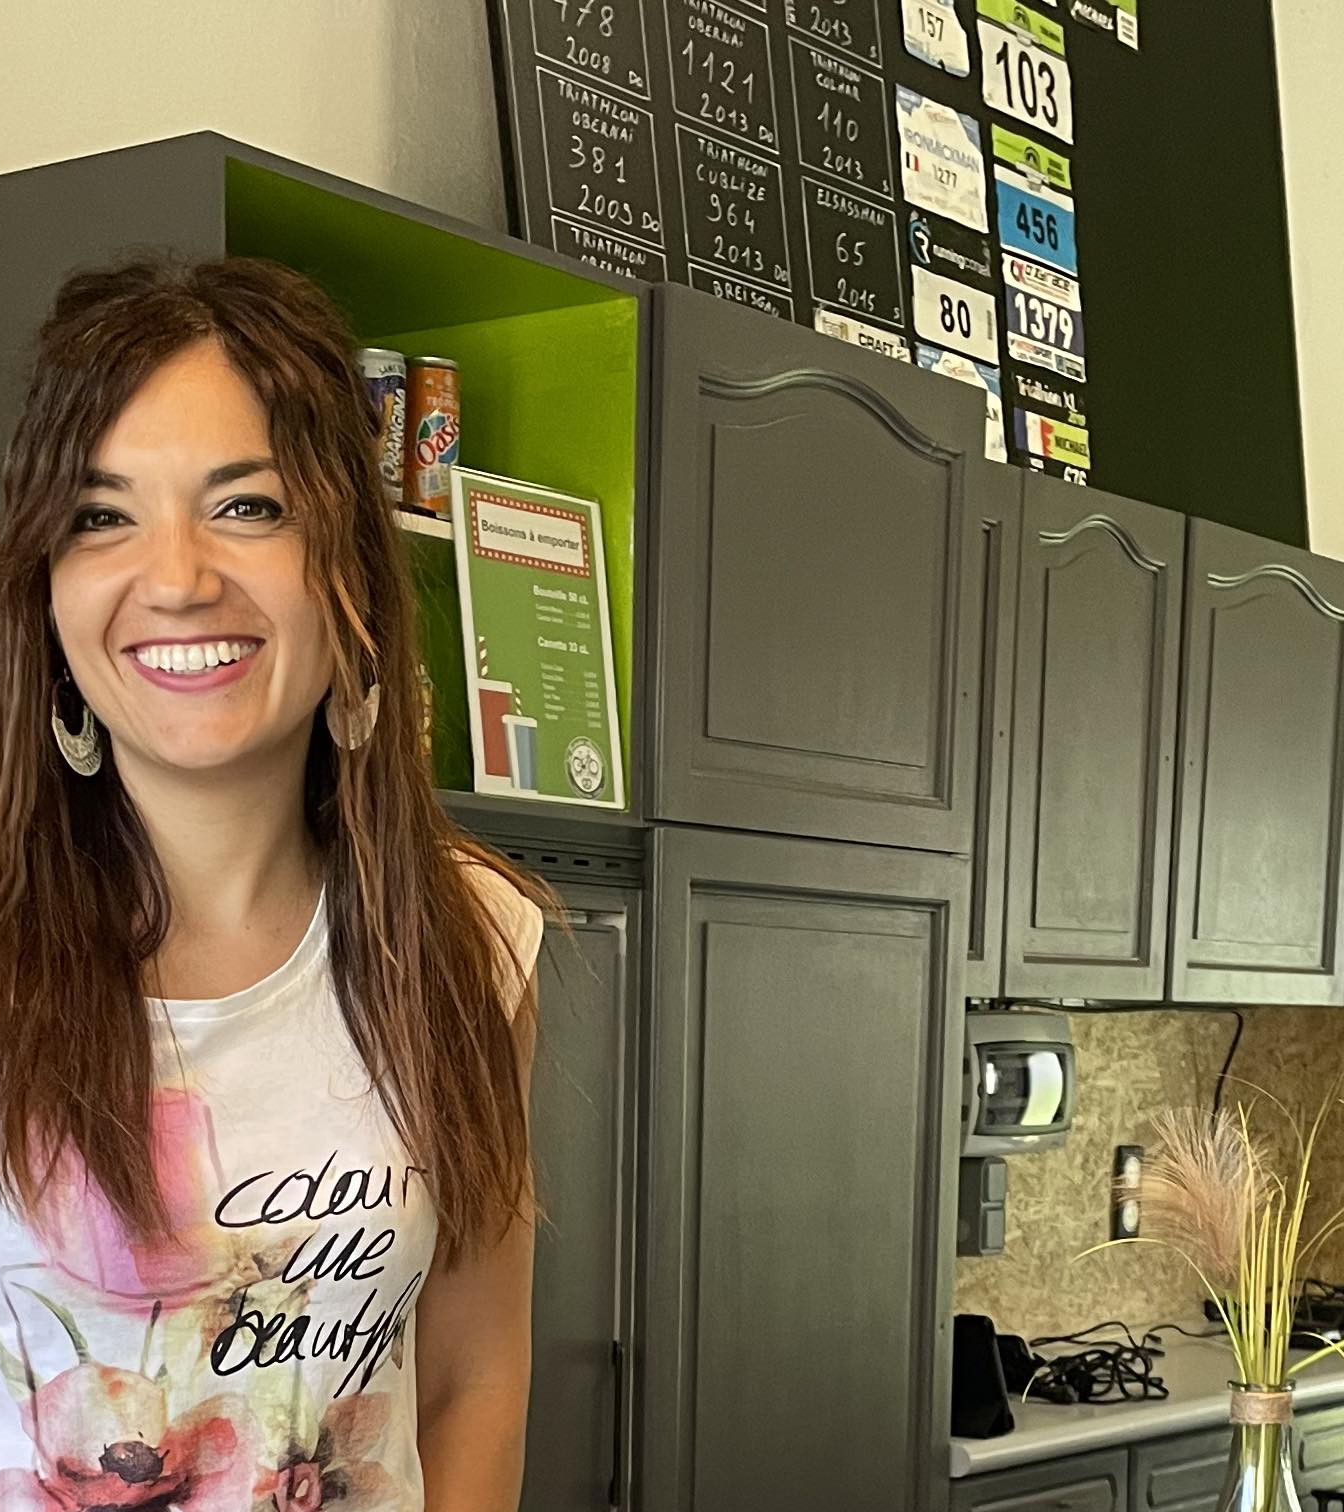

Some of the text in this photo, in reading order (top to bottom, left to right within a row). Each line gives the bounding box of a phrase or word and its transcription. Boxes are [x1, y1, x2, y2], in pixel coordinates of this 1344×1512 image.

[810, 6, 852, 46] 2013
[918, 8, 944, 42] 157
[566, 36, 611, 74] 2008
[681, 40, 754, 104] 1121
[996, 41, 1058, 128] 103
[700, 93, 748, 132] 2013
[817, 102, 859, 141] 110
[568, 135, 626, 183] 381
[822, 146, 864, 180] 2013
[577, 184, 633, 225] 2009
[706, 193, 755, 234] 964
[1016, 202, 1058, 250] 456
[714, 235, 764, 271] 2013
[835, 232, 867, 266] 65
[837, 278, 876, 312] 2015
[940, 294, 971, 338] 80
[1014, 293, 1074, 349] 1379
[858, 333, 894, 357] CRAFT
[417, 414, 460, 465] Oasis
[481, 519, 527, 539] Boissons
[537, 535, 580, 550] emporter
[214, 1150, 428, 1228] colour
